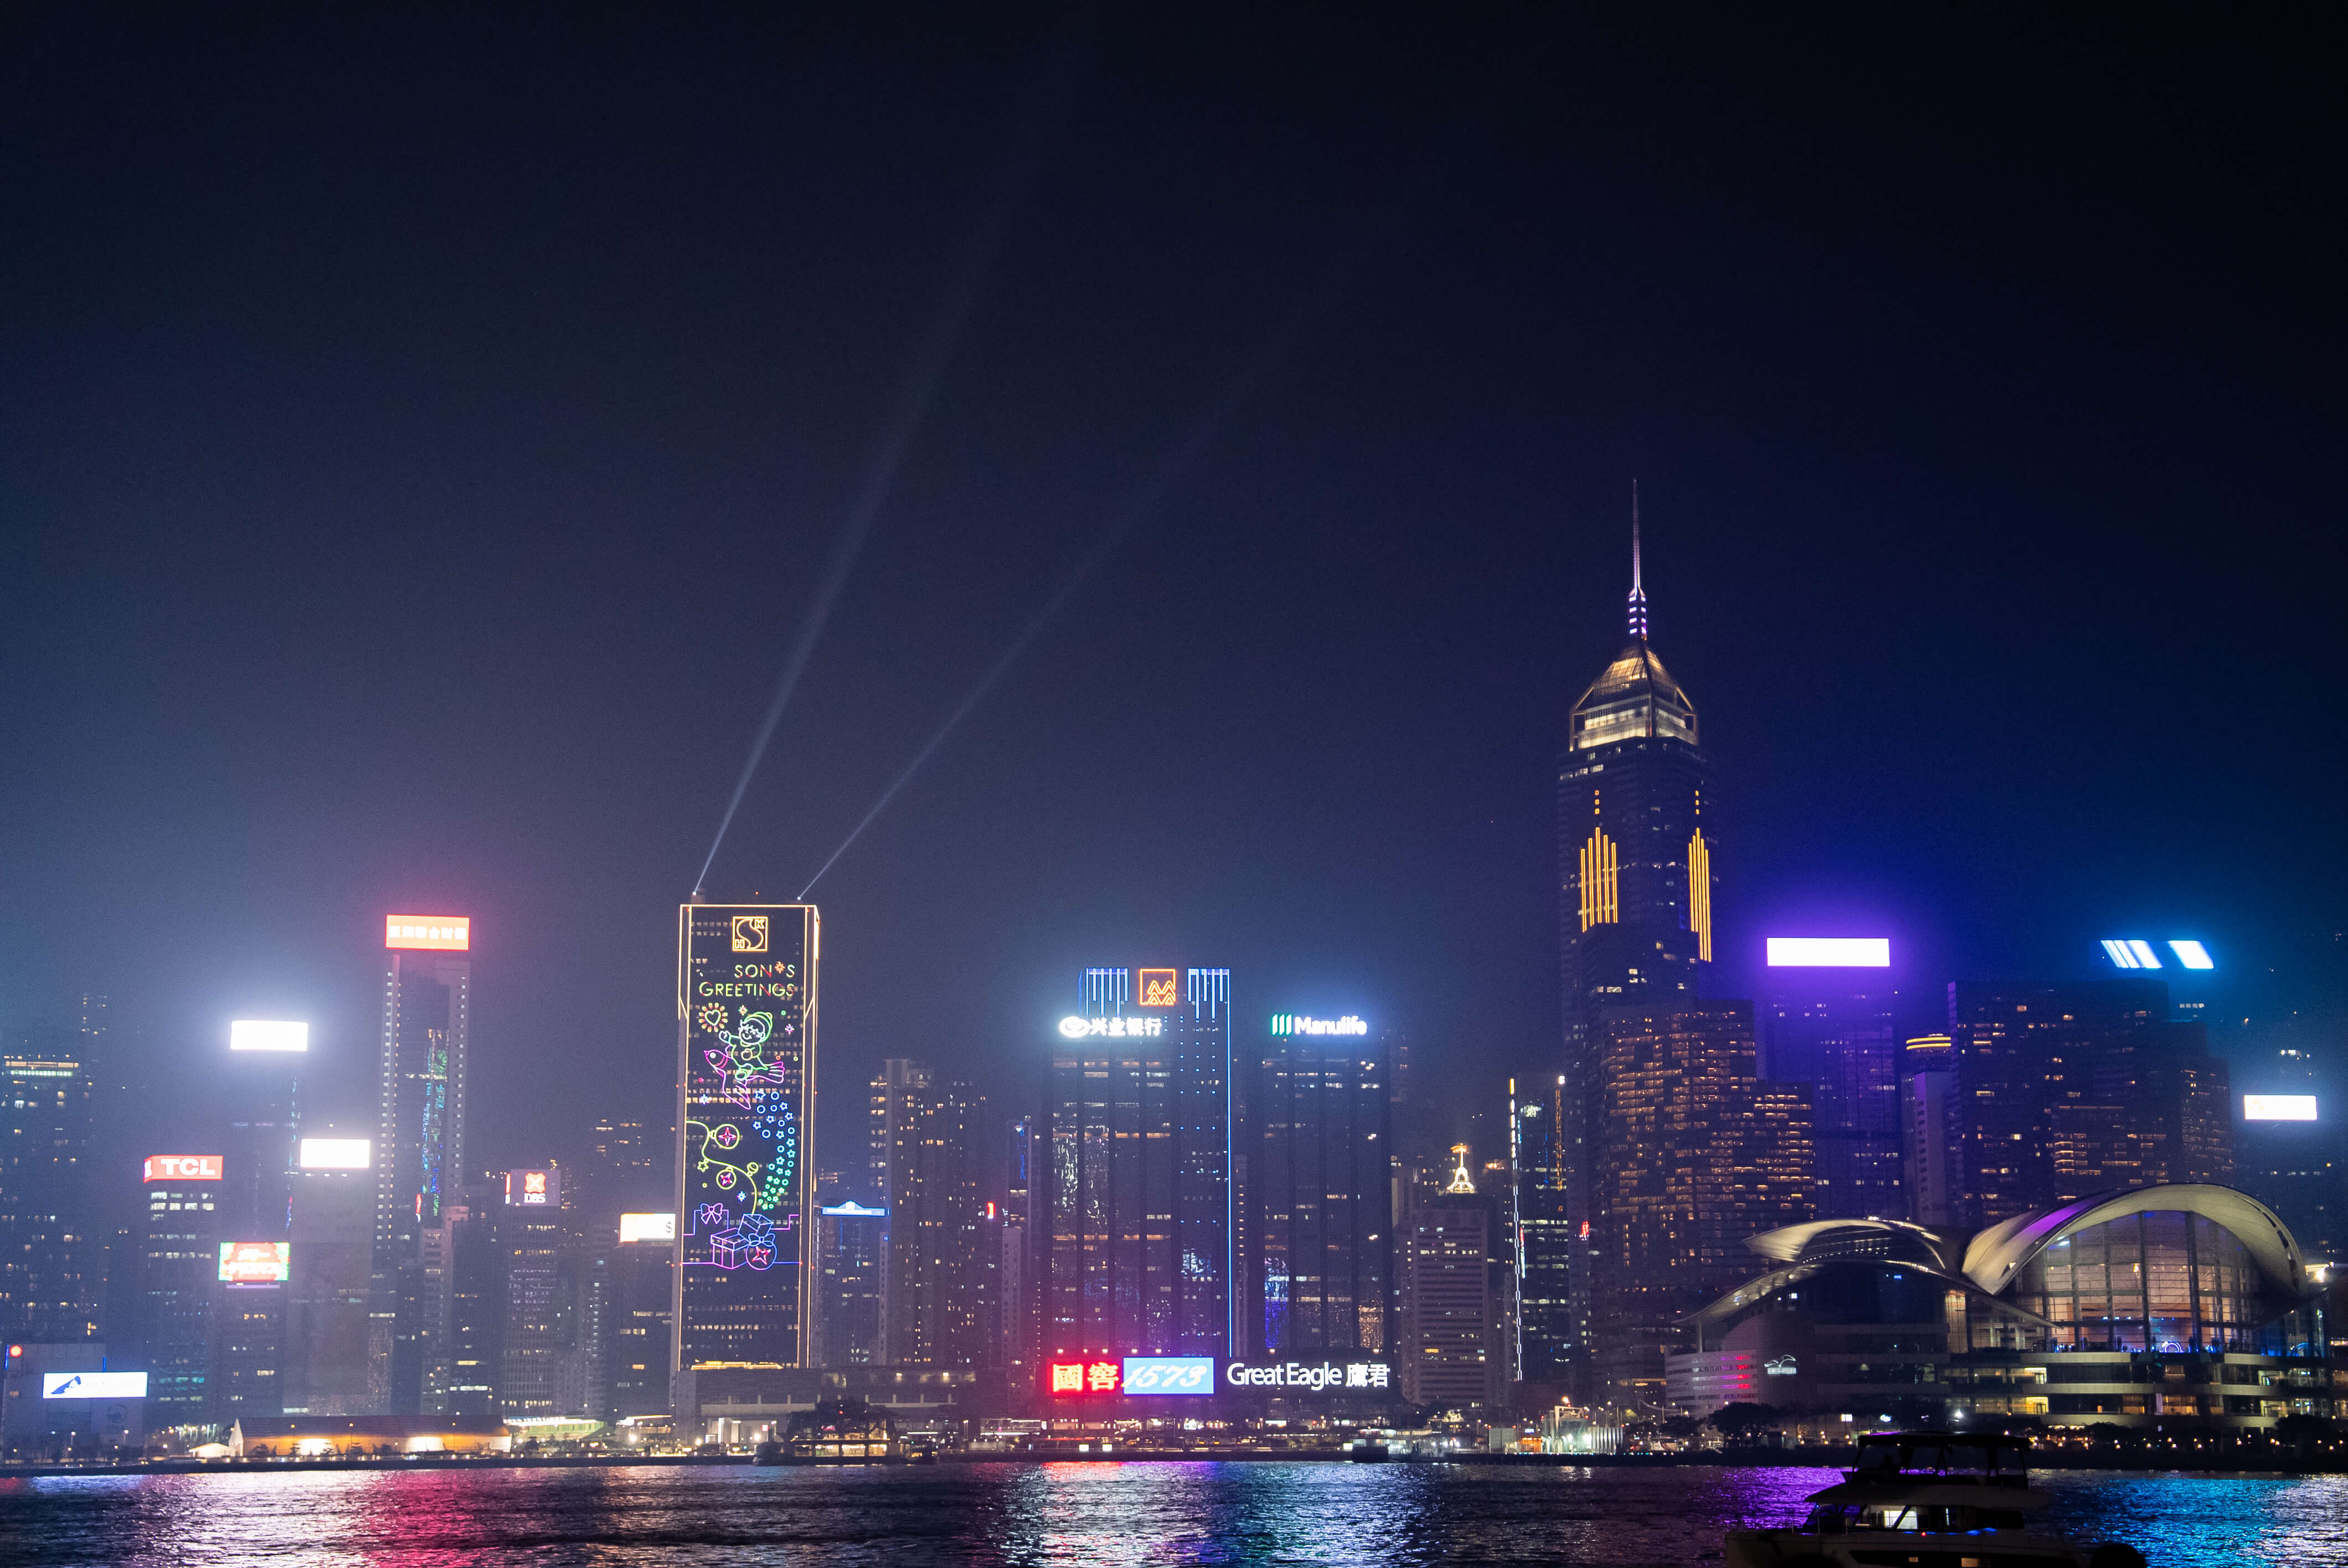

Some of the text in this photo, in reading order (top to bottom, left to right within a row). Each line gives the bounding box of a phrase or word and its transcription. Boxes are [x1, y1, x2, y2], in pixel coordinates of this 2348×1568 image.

[699, 981, 795, 997] GREETINGS
[1089, 1017, 1162, 1036] 兴业银行
[1294, 1015, 1368, 1035] Manulife
[160, 1158, 215, 1176] TCL
[523, 1193, 546, 1204] DBS
[1227, 1363, 1285, 1385] Great
[1286, 1361, 1342, 1391] Eagle
